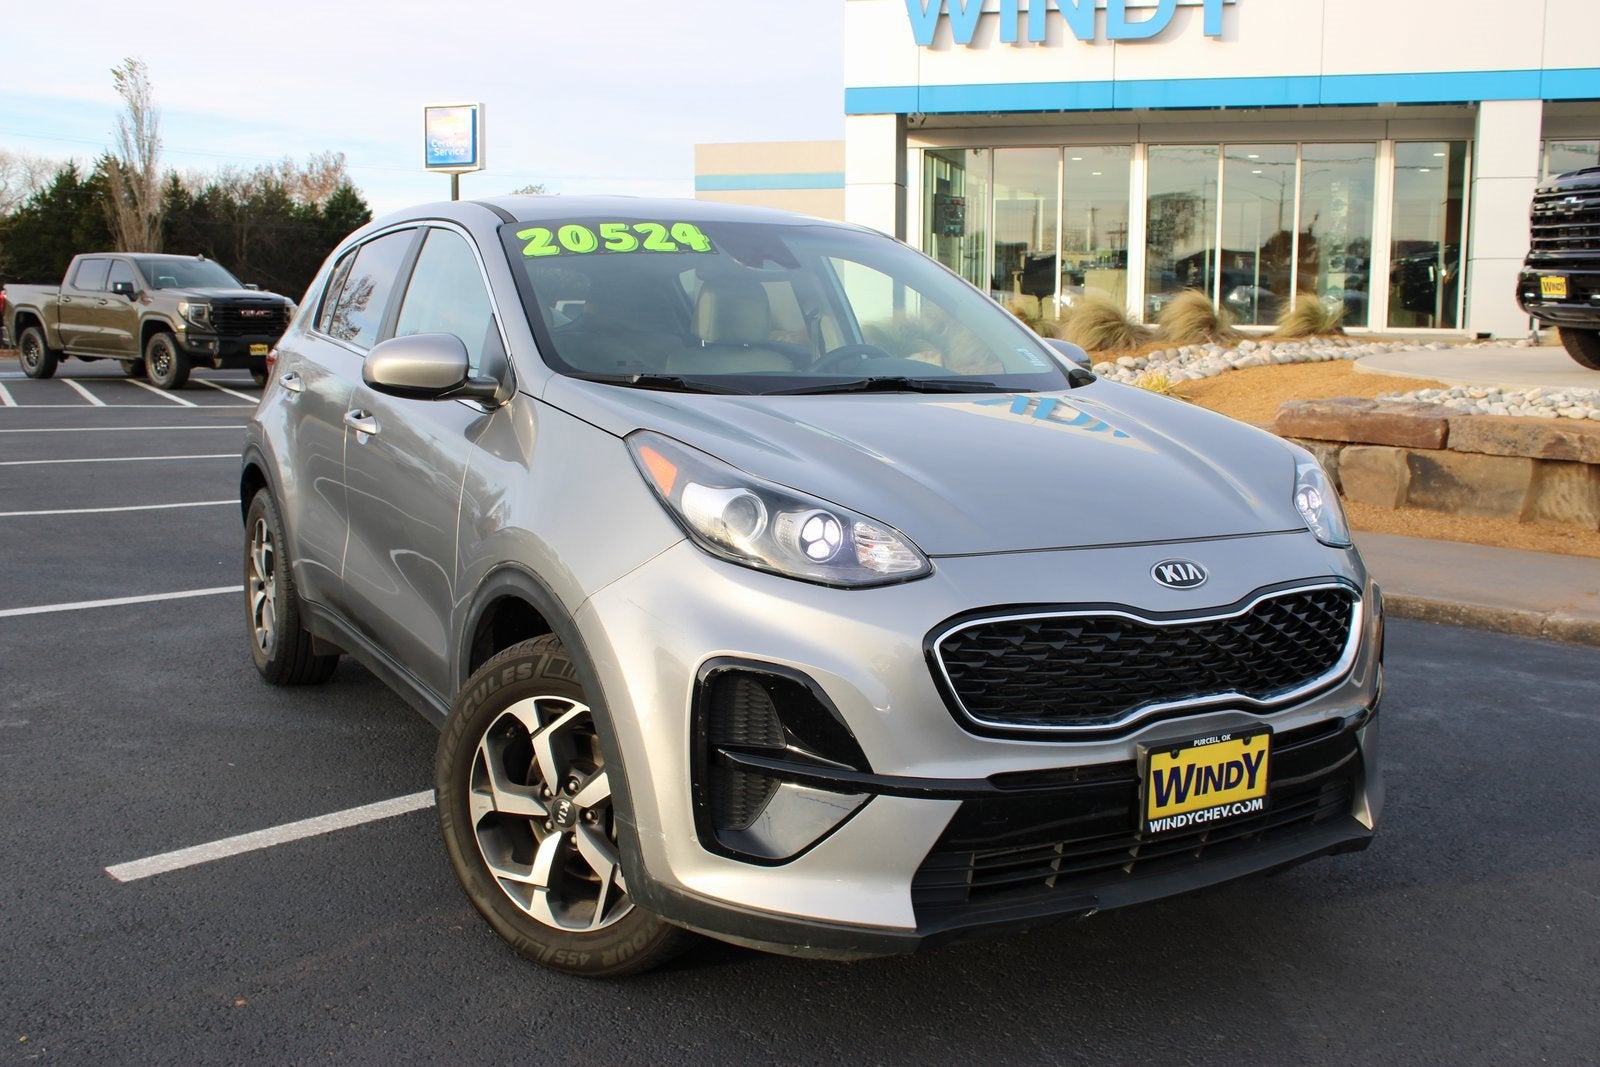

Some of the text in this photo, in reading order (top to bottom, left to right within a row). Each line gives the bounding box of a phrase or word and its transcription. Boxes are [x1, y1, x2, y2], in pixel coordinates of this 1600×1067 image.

[434, 147, 465, 157] Service
[516, 222, 711, 257] 20524
[1158, 563, 1203, 583] KIA
[1193, 733, 1232, 747] PURCELL, OK
[1152, 749, 1266, 808] WINDY
[557, 800, 571, 824] KIA
[1150, 798, 1264, 833] WINDYCHEV.COM
[555, 948, 591, 966] 455
